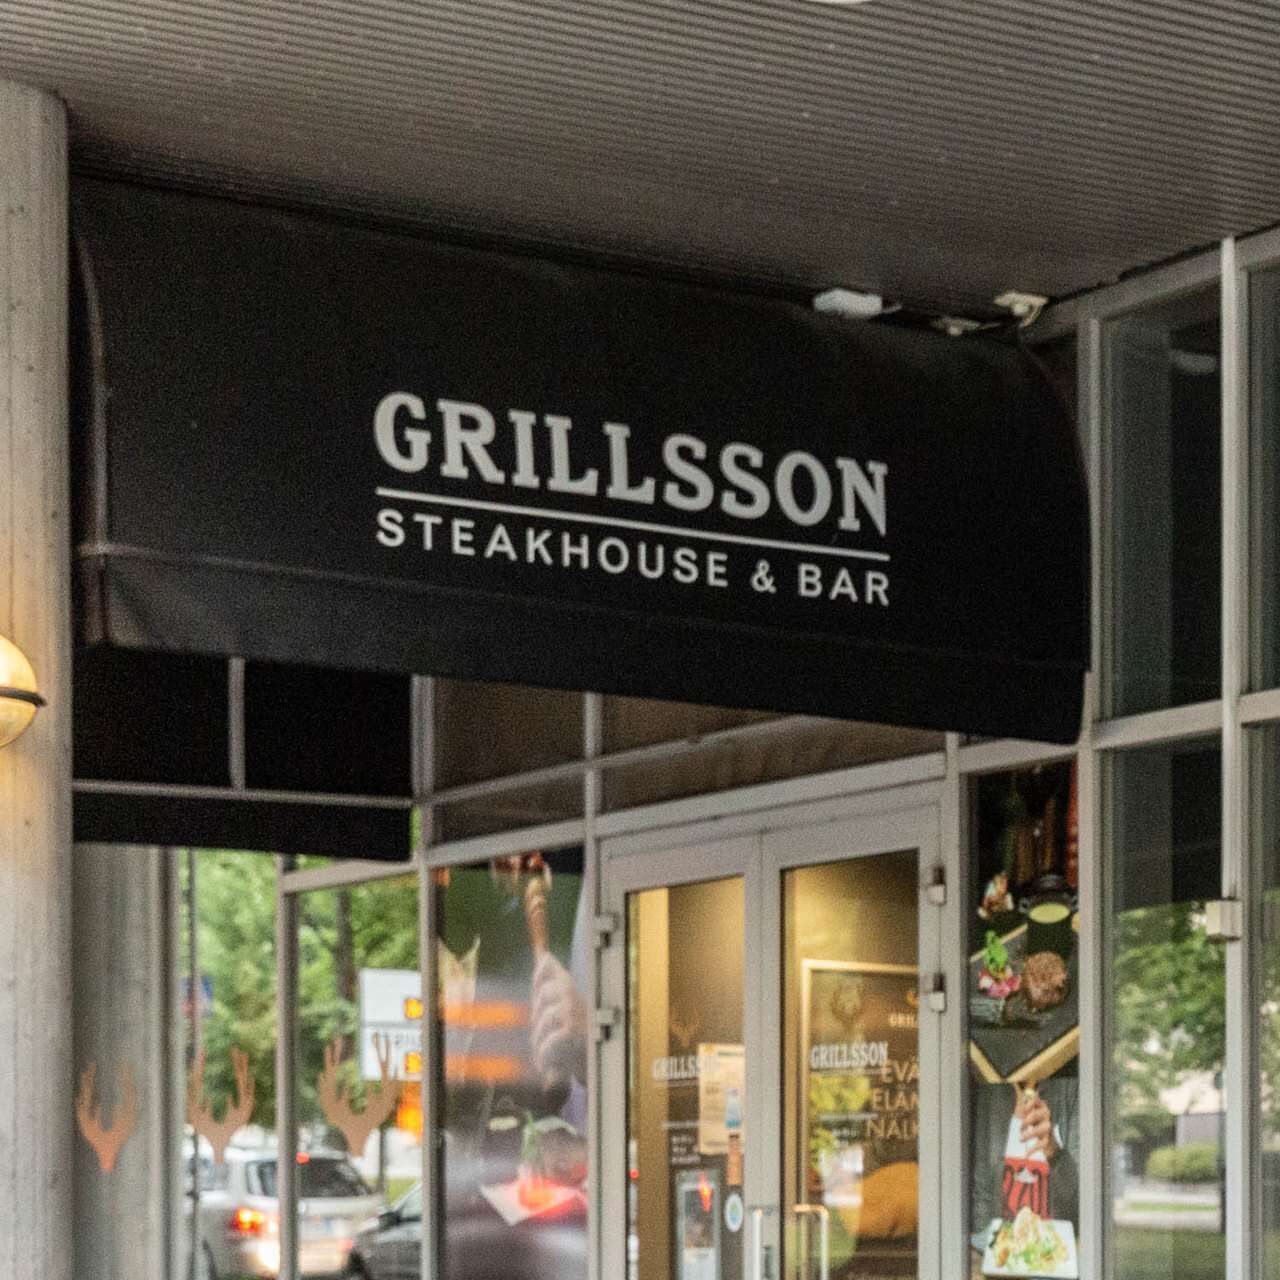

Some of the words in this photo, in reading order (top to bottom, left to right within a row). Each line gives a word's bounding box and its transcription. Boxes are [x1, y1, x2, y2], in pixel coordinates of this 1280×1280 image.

[373, 391, 888, 537] GRILLSSON
[375, 508, 728, 588] STEAKHOUSE
[751, 560, 777, 594] &
[798, 563, 889, 606] BAR
[810, 1041, 888, 1069] GRILLSSON
